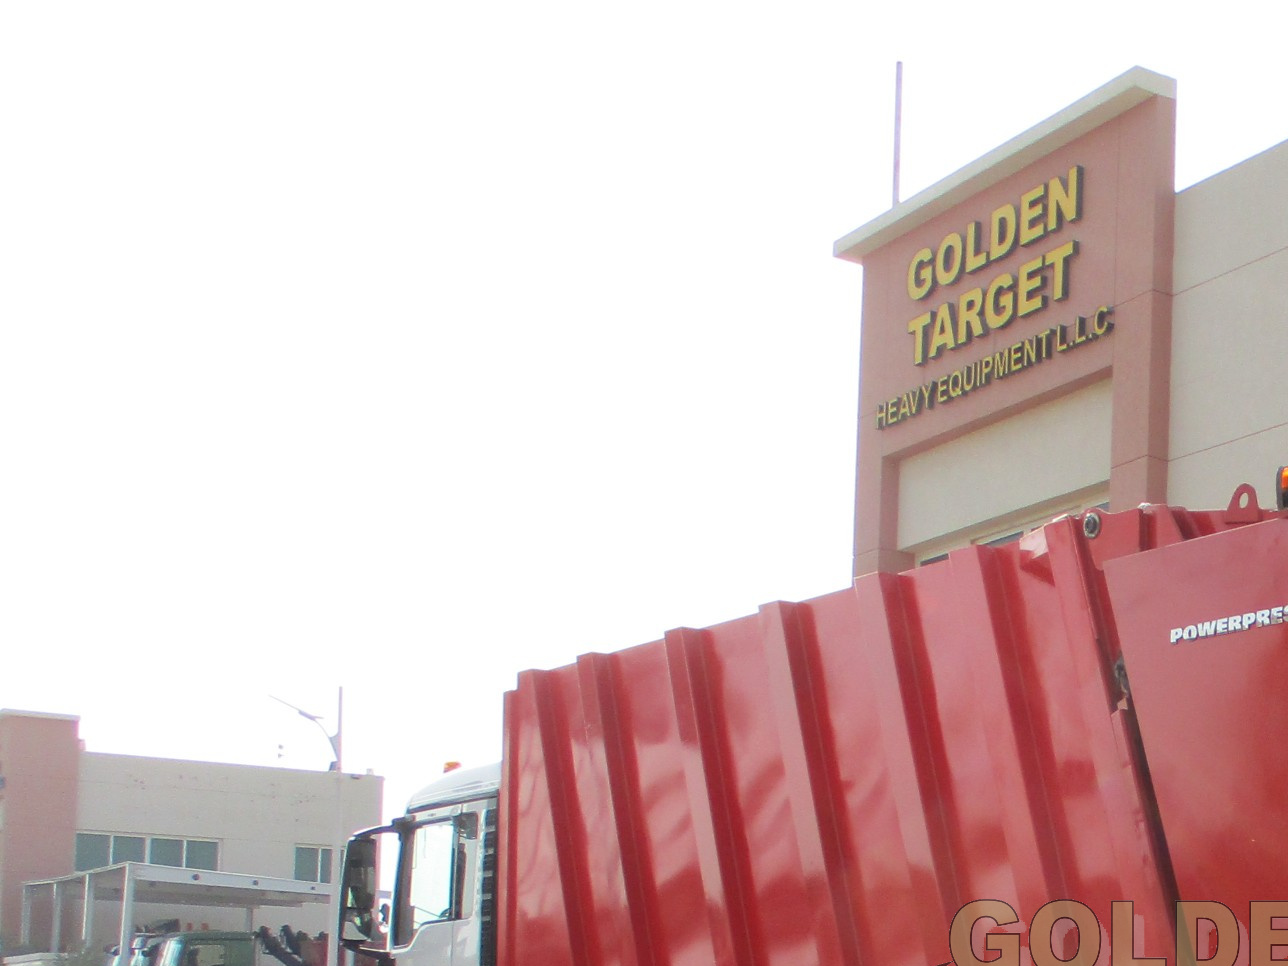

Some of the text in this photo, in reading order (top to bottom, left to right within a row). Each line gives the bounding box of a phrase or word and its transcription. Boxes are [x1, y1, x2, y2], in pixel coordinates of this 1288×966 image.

[907, 165, 1084, 301] GOLDEN
[907, 240, 1080, 366] TARGET
[876, 381, 936, 430] HEAVY
[936, 327, 1052, 405] EQUIPMENT
